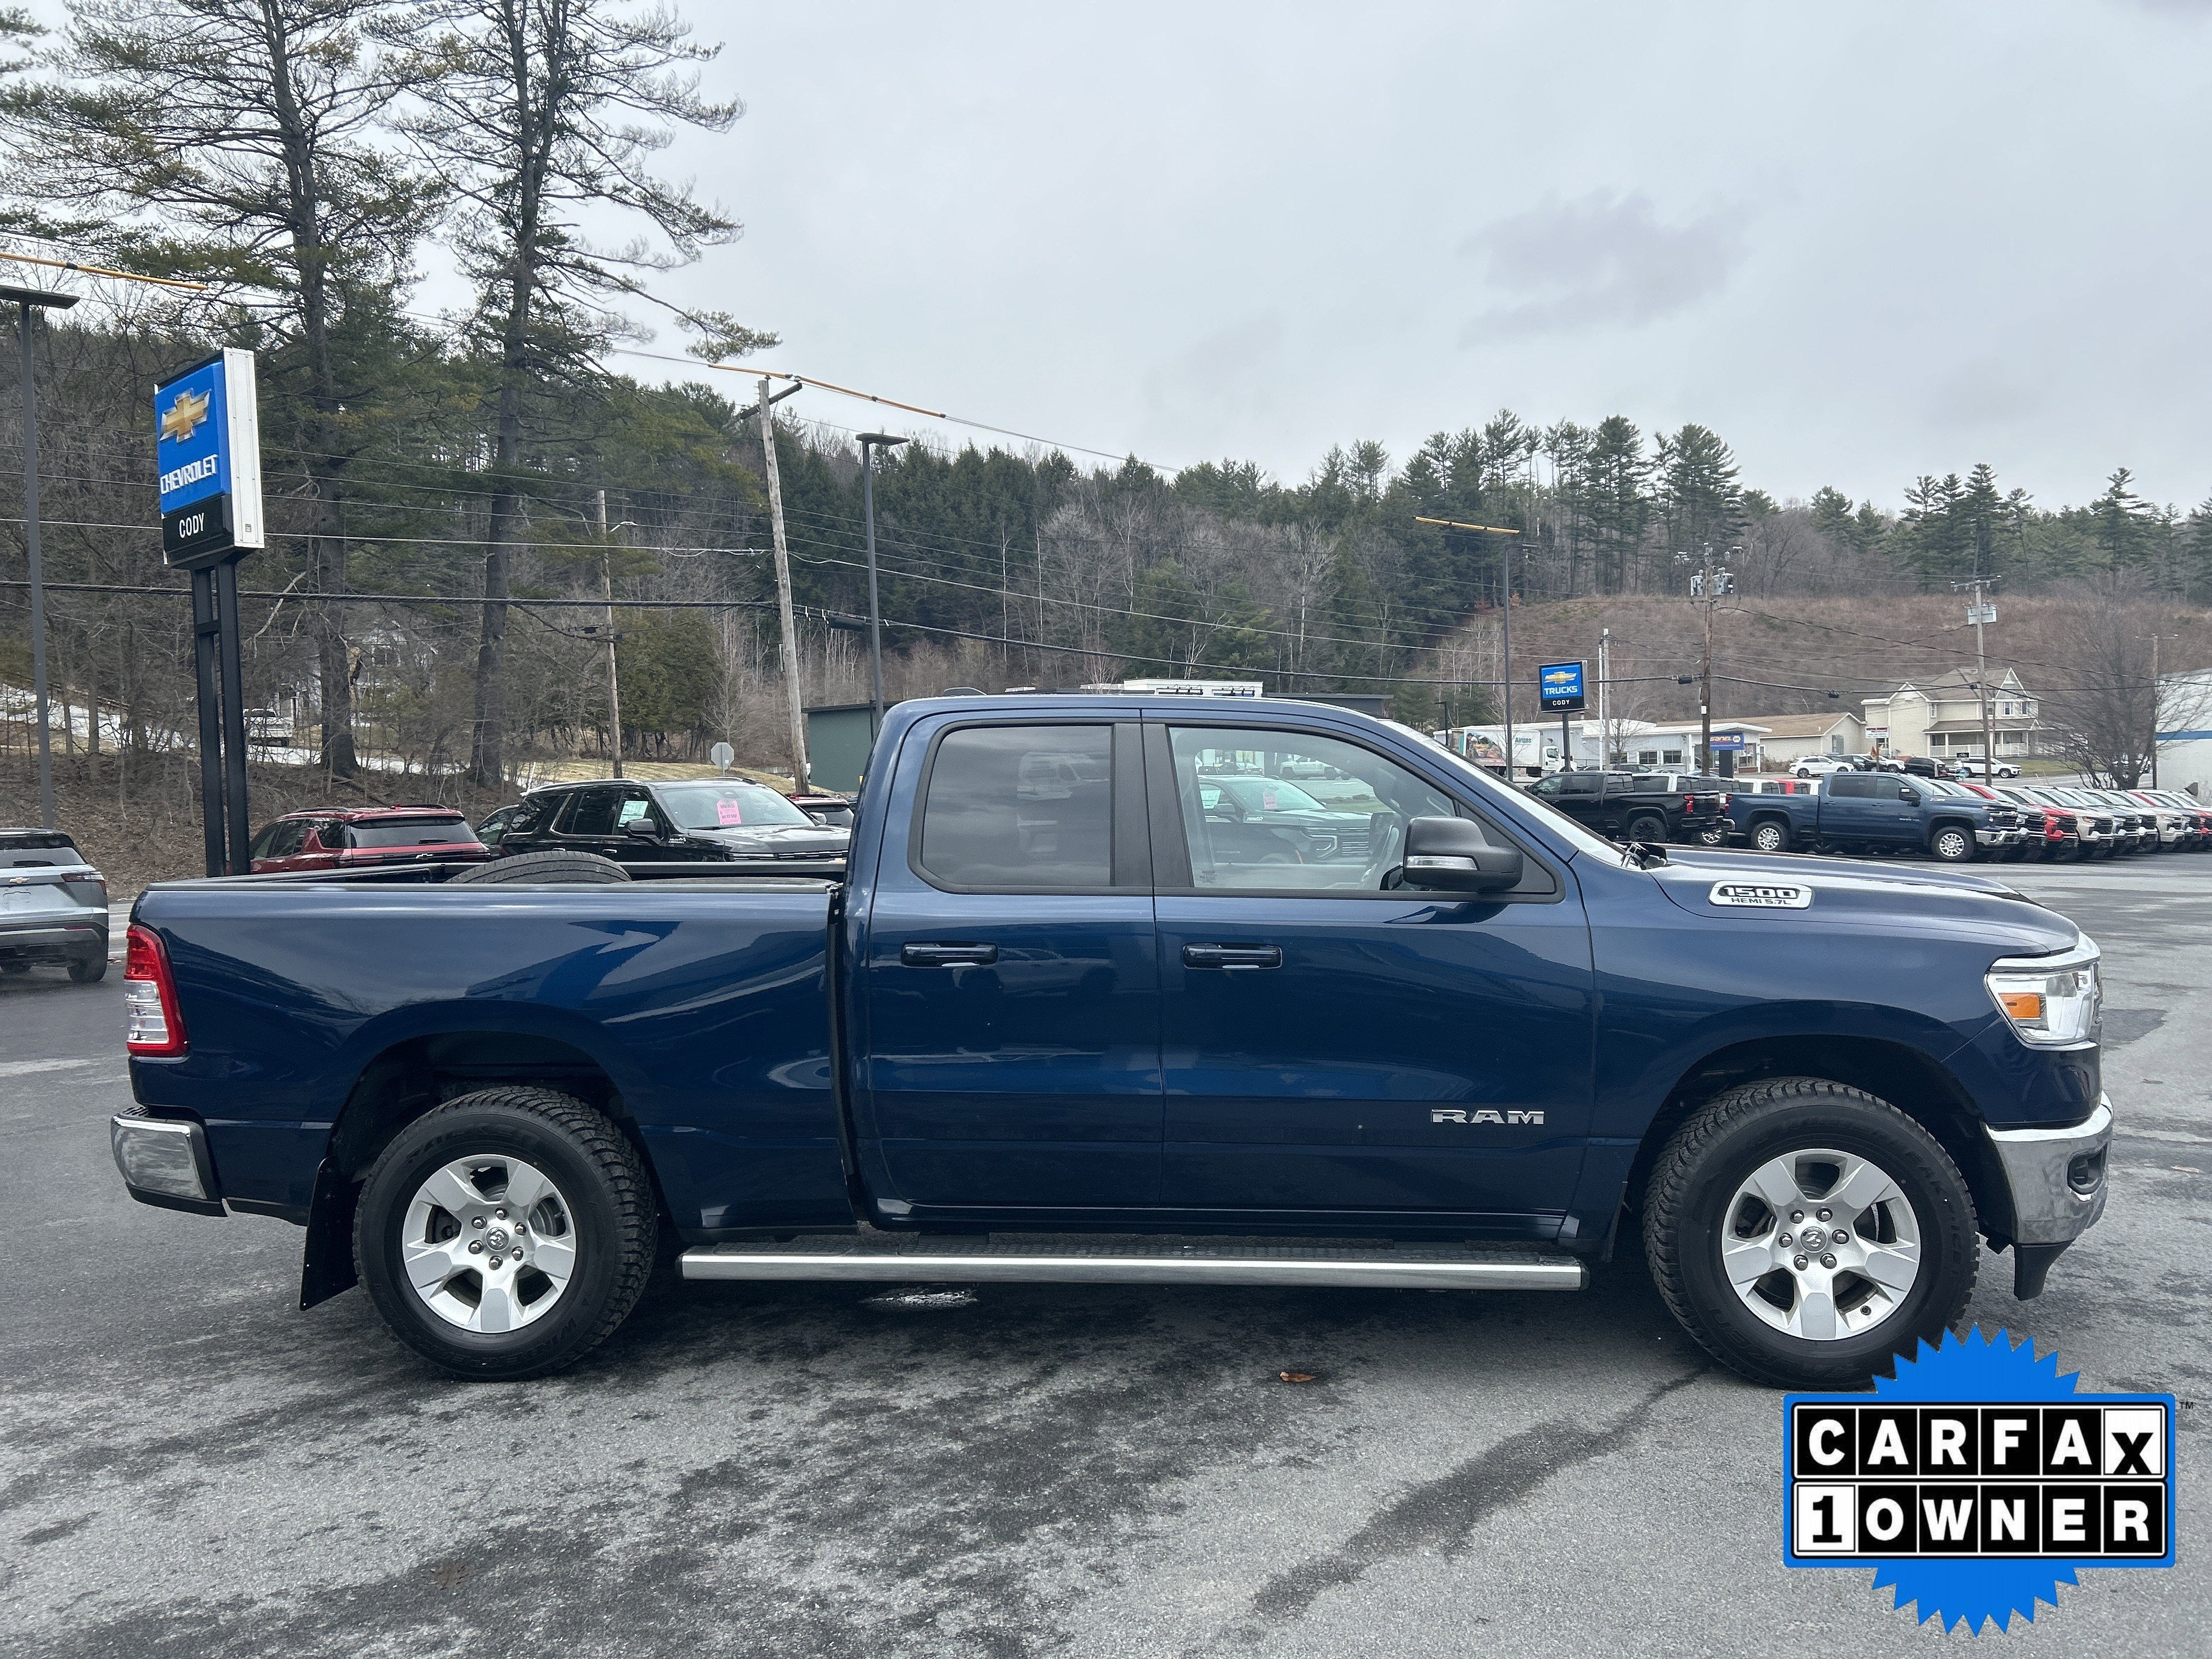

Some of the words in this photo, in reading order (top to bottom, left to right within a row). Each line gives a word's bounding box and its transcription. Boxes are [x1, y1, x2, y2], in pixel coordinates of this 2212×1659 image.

[160, 454, 218, 494] CHEVROLET
[179, 513, 205, 539] CODY
[1544, 685, 1578, 696] TRUCKS
[1723, 887, 1798, 899] 1500
[1431, 1109, 1545, 1125] RAM
